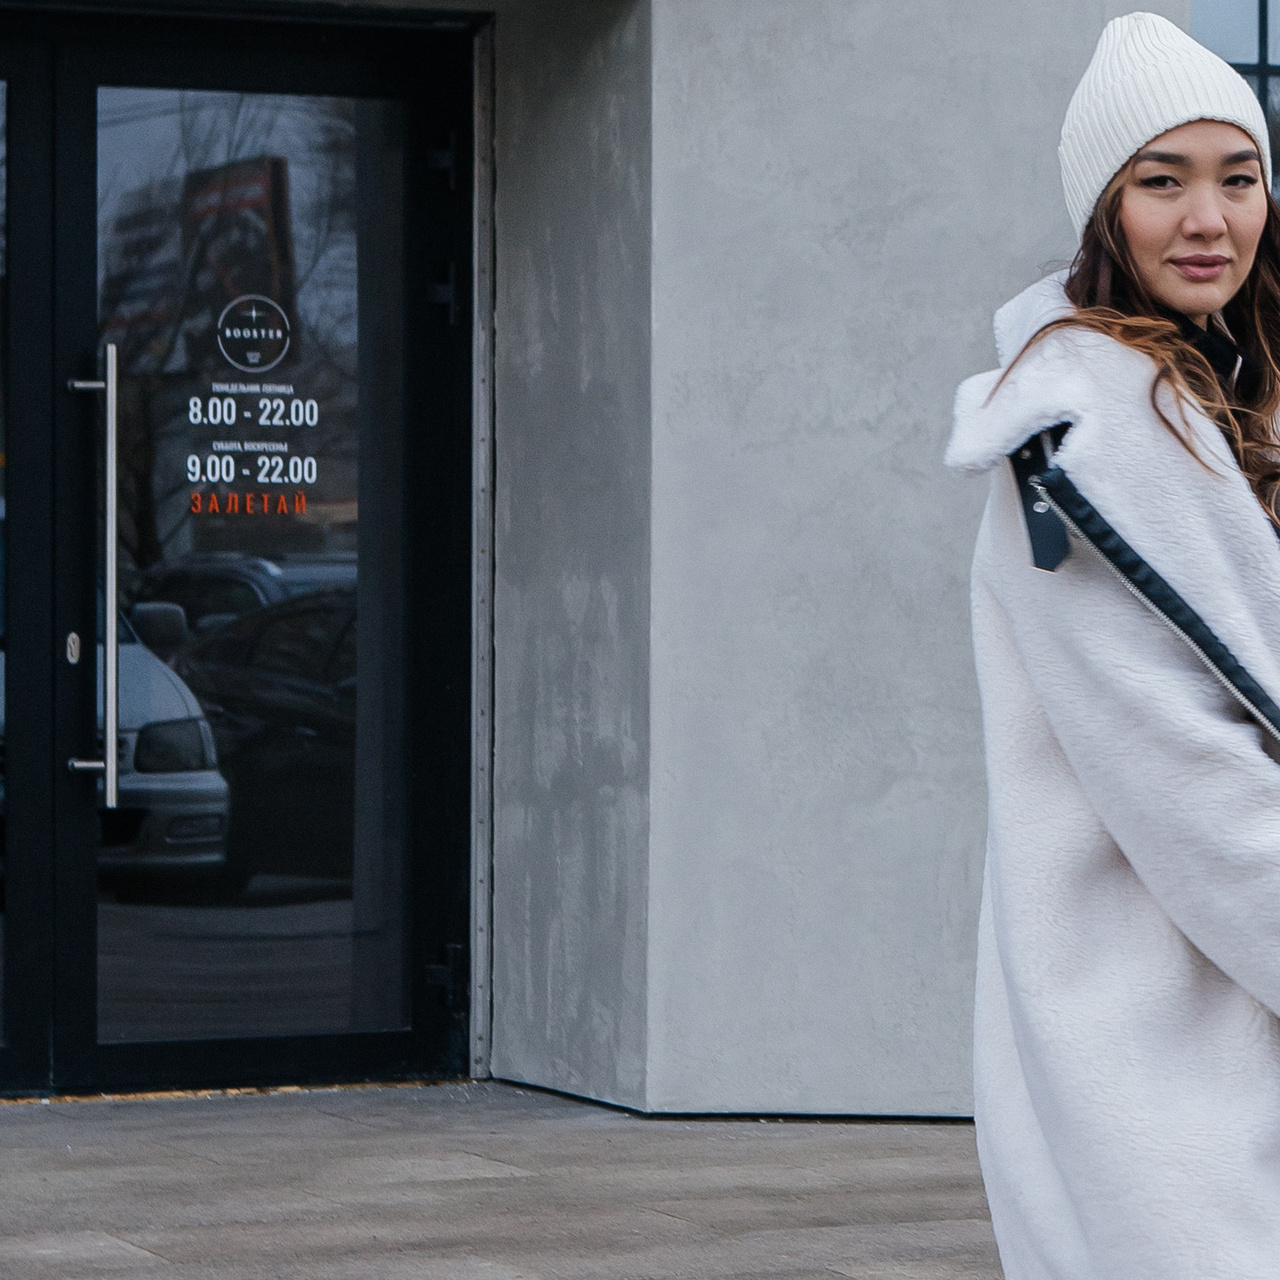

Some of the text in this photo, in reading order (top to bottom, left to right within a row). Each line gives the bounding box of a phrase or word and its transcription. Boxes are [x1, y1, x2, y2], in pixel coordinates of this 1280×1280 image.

[225, 327, 282, 339] BOOSTER
[189, 396, 236, 425] 8.00
[258, 398, 318, 427] 22.00
[187, 454, 235, 483] 9.00
[257, 455, 317, 484] 22.00
[191, 491, 306, 514] ЗАЛЕТАЙ
